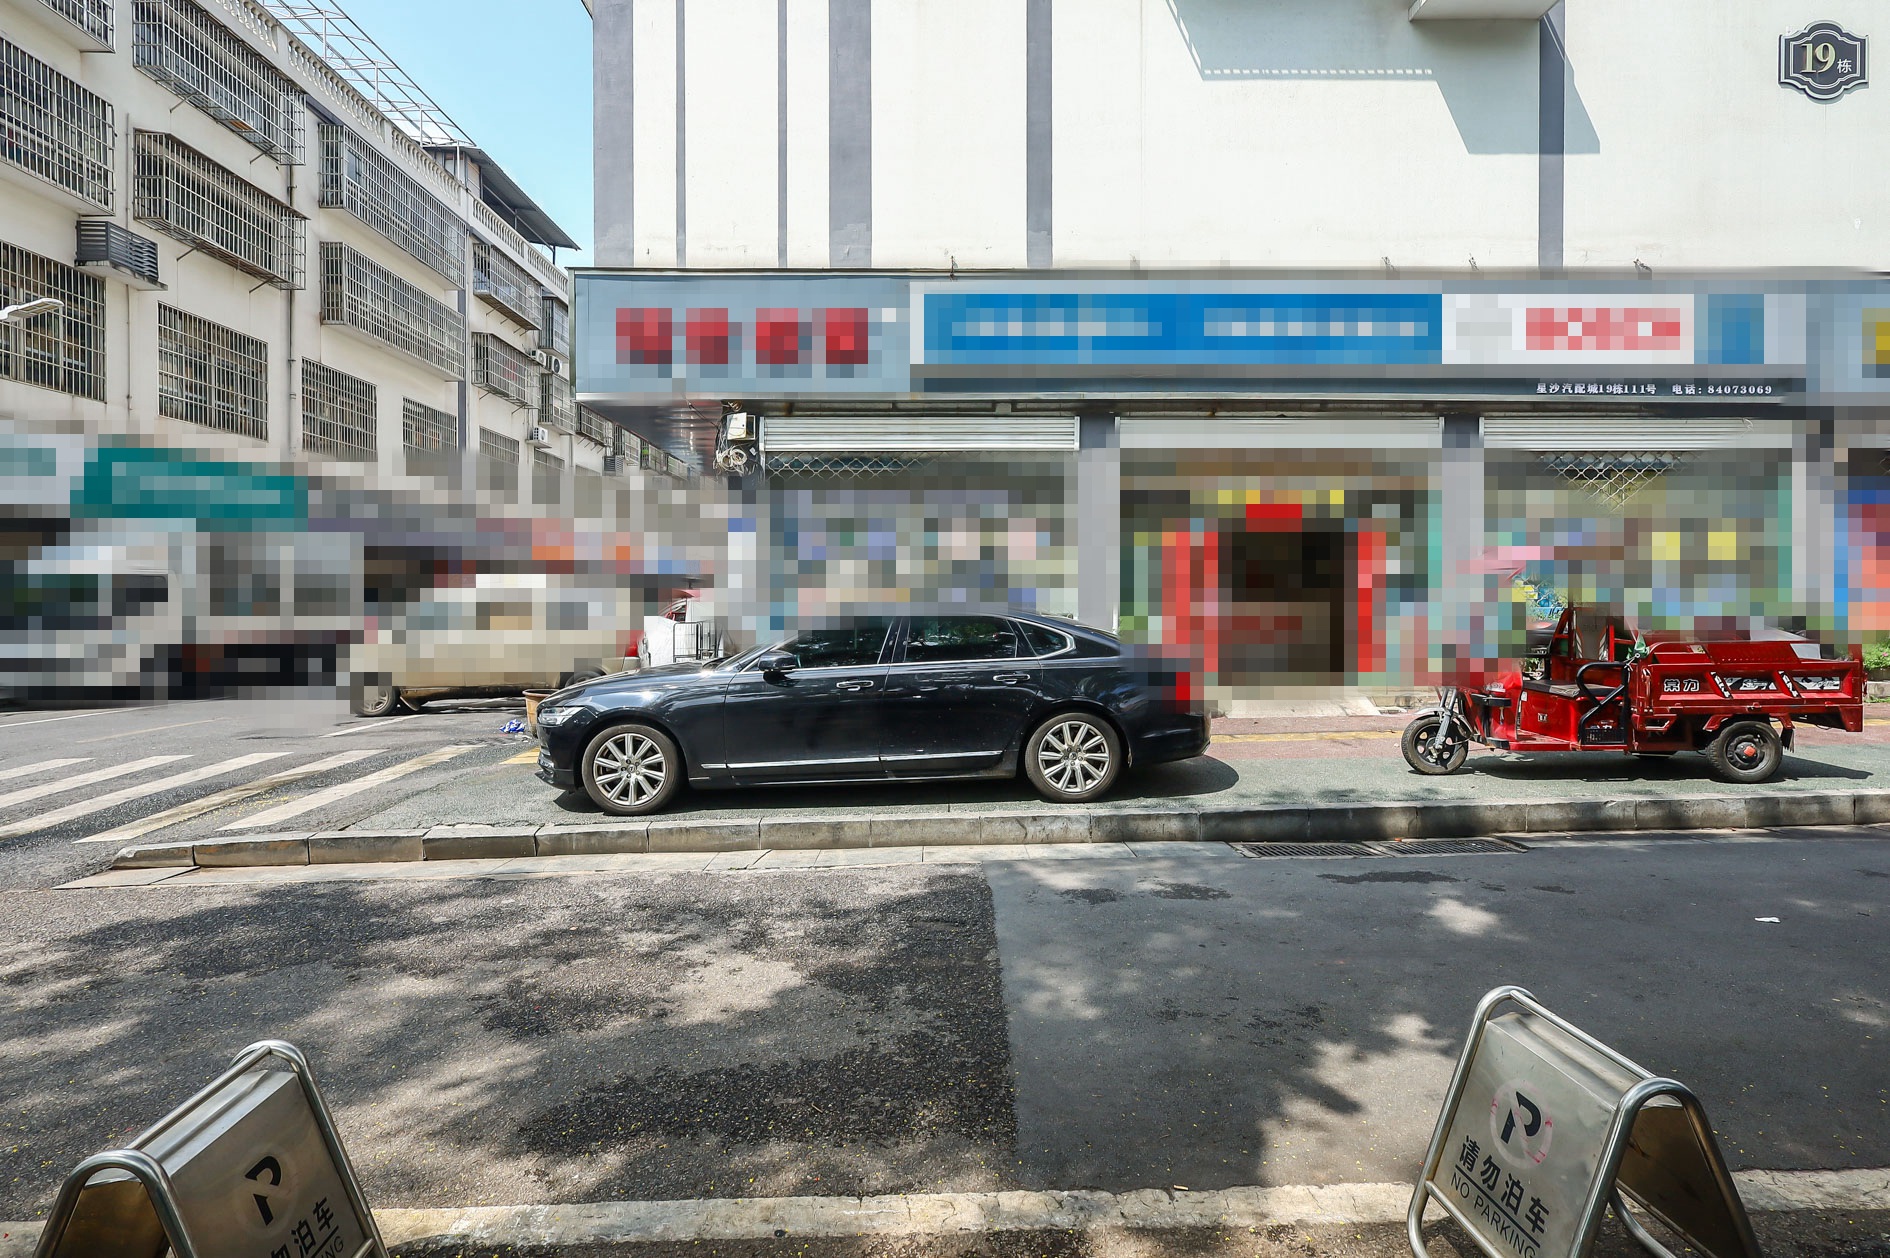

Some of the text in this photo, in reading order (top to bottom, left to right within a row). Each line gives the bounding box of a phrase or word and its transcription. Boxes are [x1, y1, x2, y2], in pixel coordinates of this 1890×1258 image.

[1800, 42, 1852, 73] 19栋
[1451, 1172, 1471, 1199] NO
[1460, 1135, 1550, 1235] 请勿泊车
